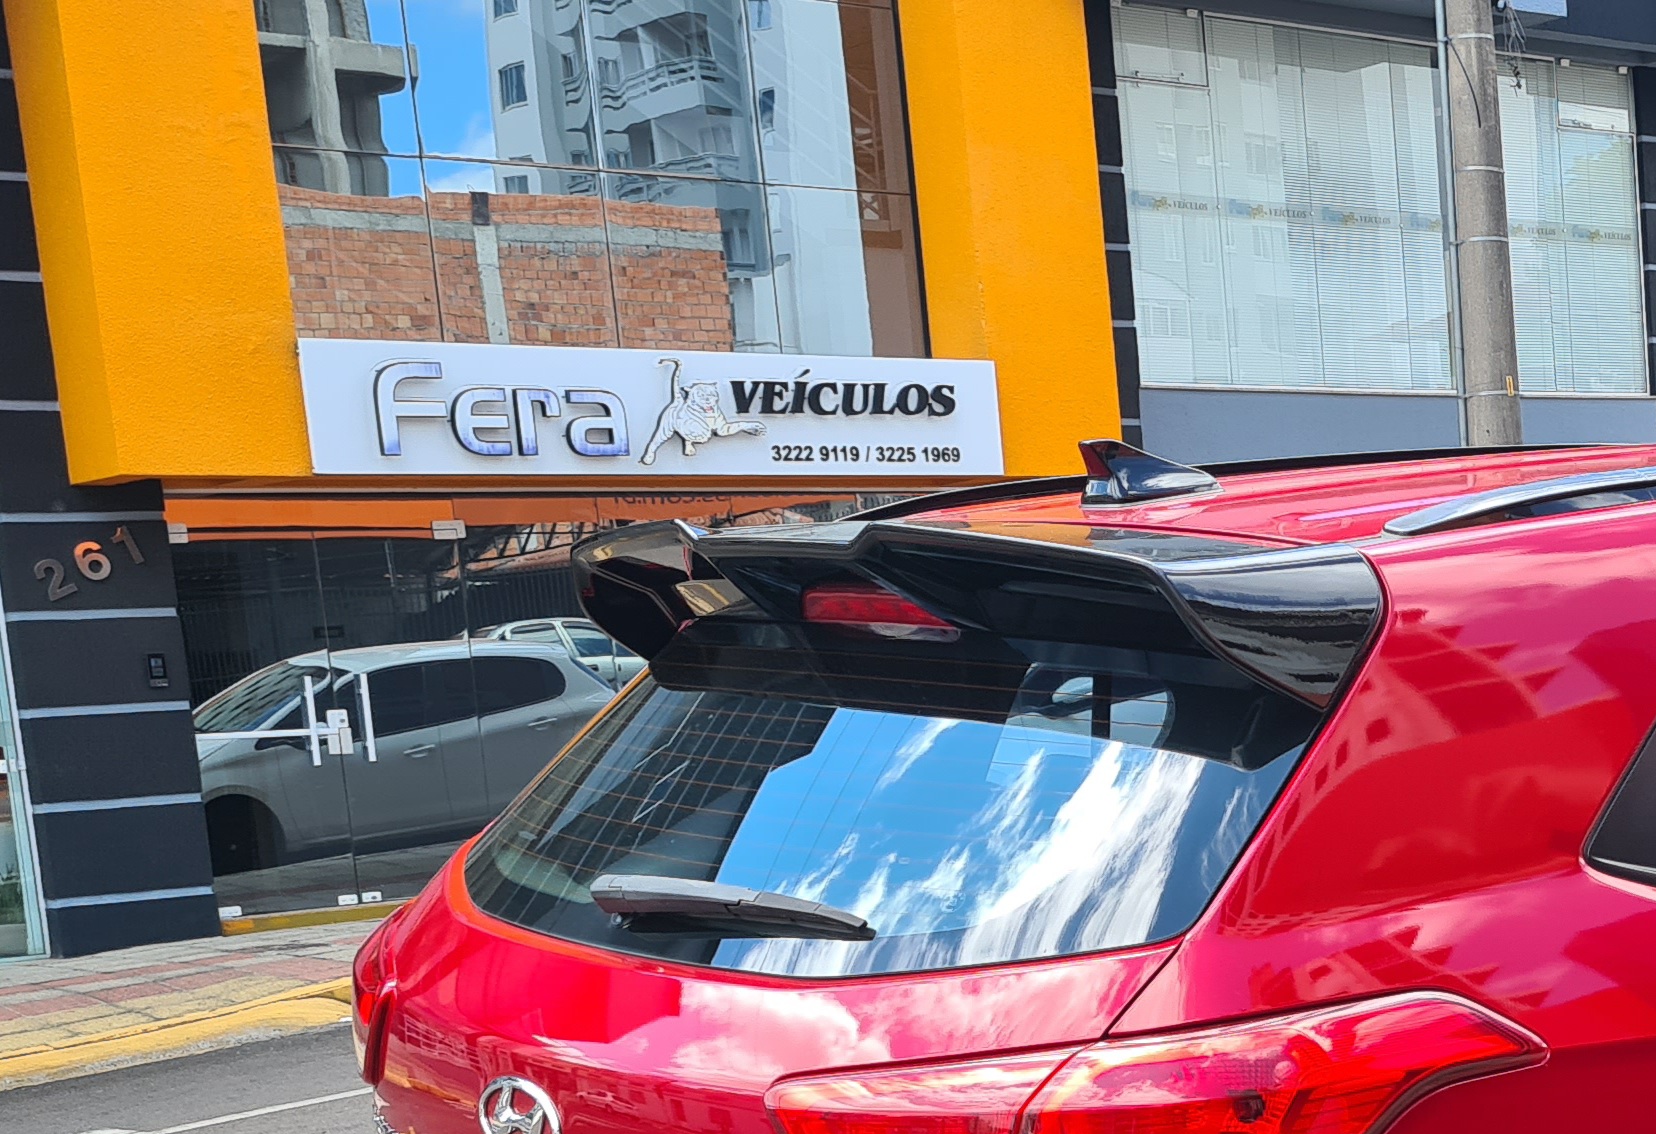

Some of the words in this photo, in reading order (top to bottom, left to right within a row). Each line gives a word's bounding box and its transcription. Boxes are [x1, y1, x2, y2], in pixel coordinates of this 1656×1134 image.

[729, 369, 957, 417] VEÍCULOS
[771, 445, 815, 462] 3222
[820, 445, 860, 462] 9119
[865, 446, 871, 462] /
[875, 447, 916, 463] 3225
[921, 446, 961, 463] 1969
[34, 525, 145, 601] 261
